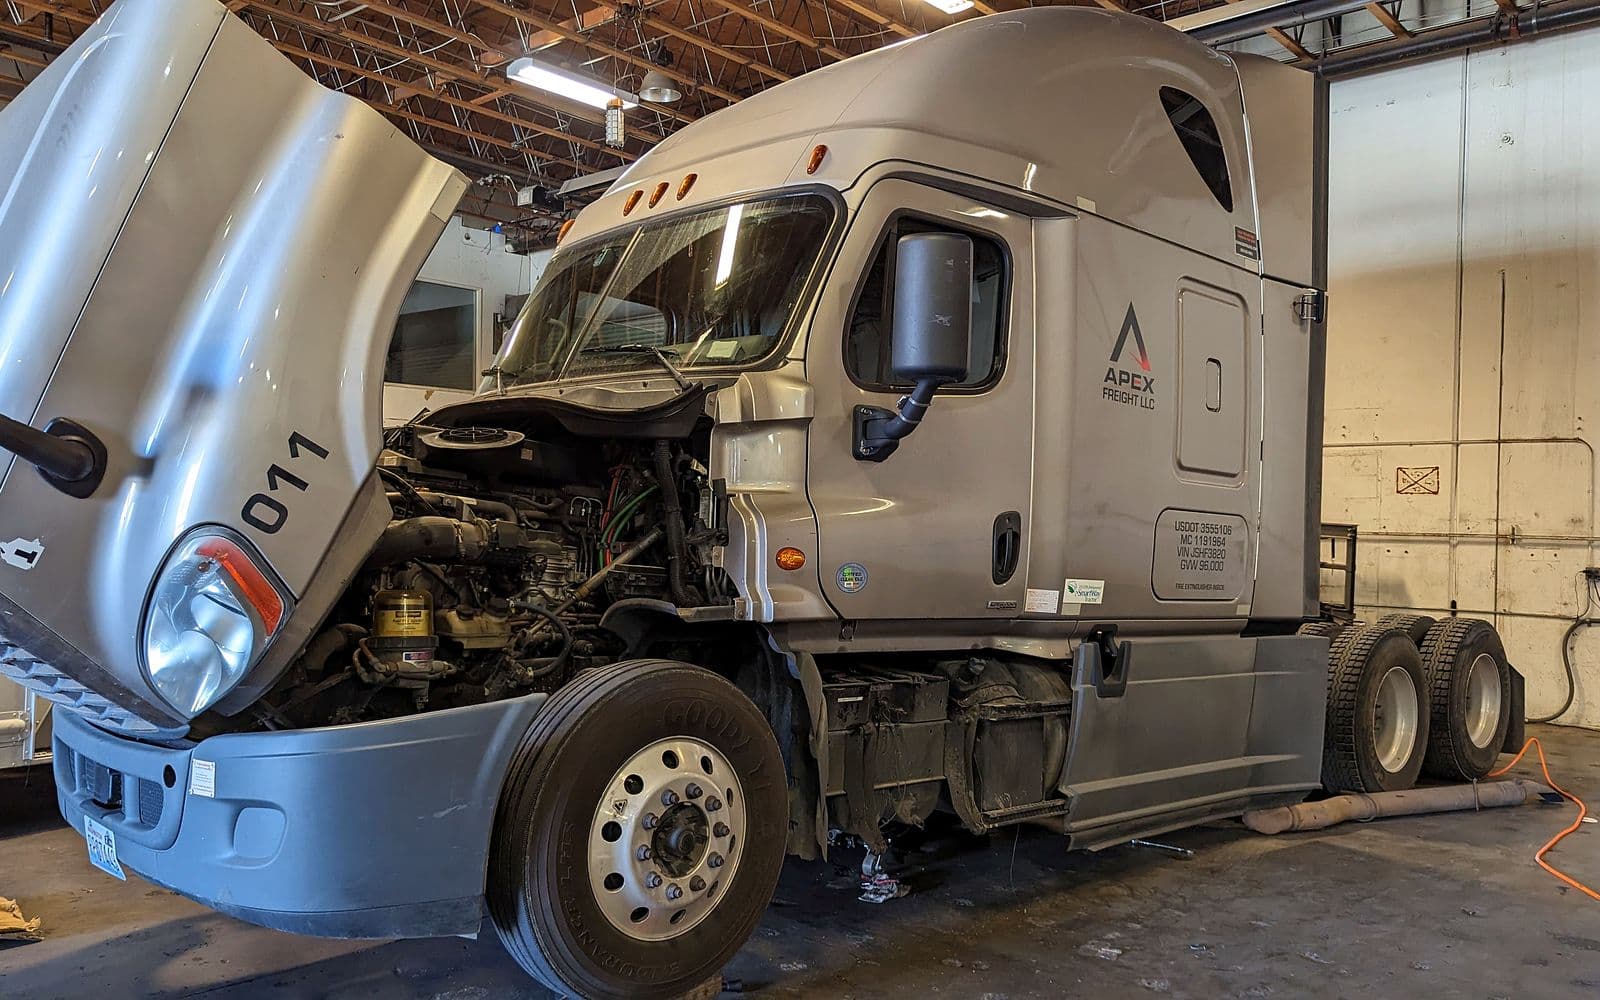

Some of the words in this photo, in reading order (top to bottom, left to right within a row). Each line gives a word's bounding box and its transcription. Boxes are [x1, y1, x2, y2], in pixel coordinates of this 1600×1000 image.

[1103, 367, 1155, 394] APEX
[1103, 387, 1139, 406] FREIGHT
[1140, 397, 1155, 410] LLC
[241, 430, 330, 535] 011
[1174, 521, 1200, 533] USDOT
[1200, 523, 1232, 535] 3555106
[1180, 534, 1192, 545] MC
[1194, 535, 1226, 547] 1191964
[1177, 546, 1189, 558] VIN
[1180, 560, 1199, 570] GVW
